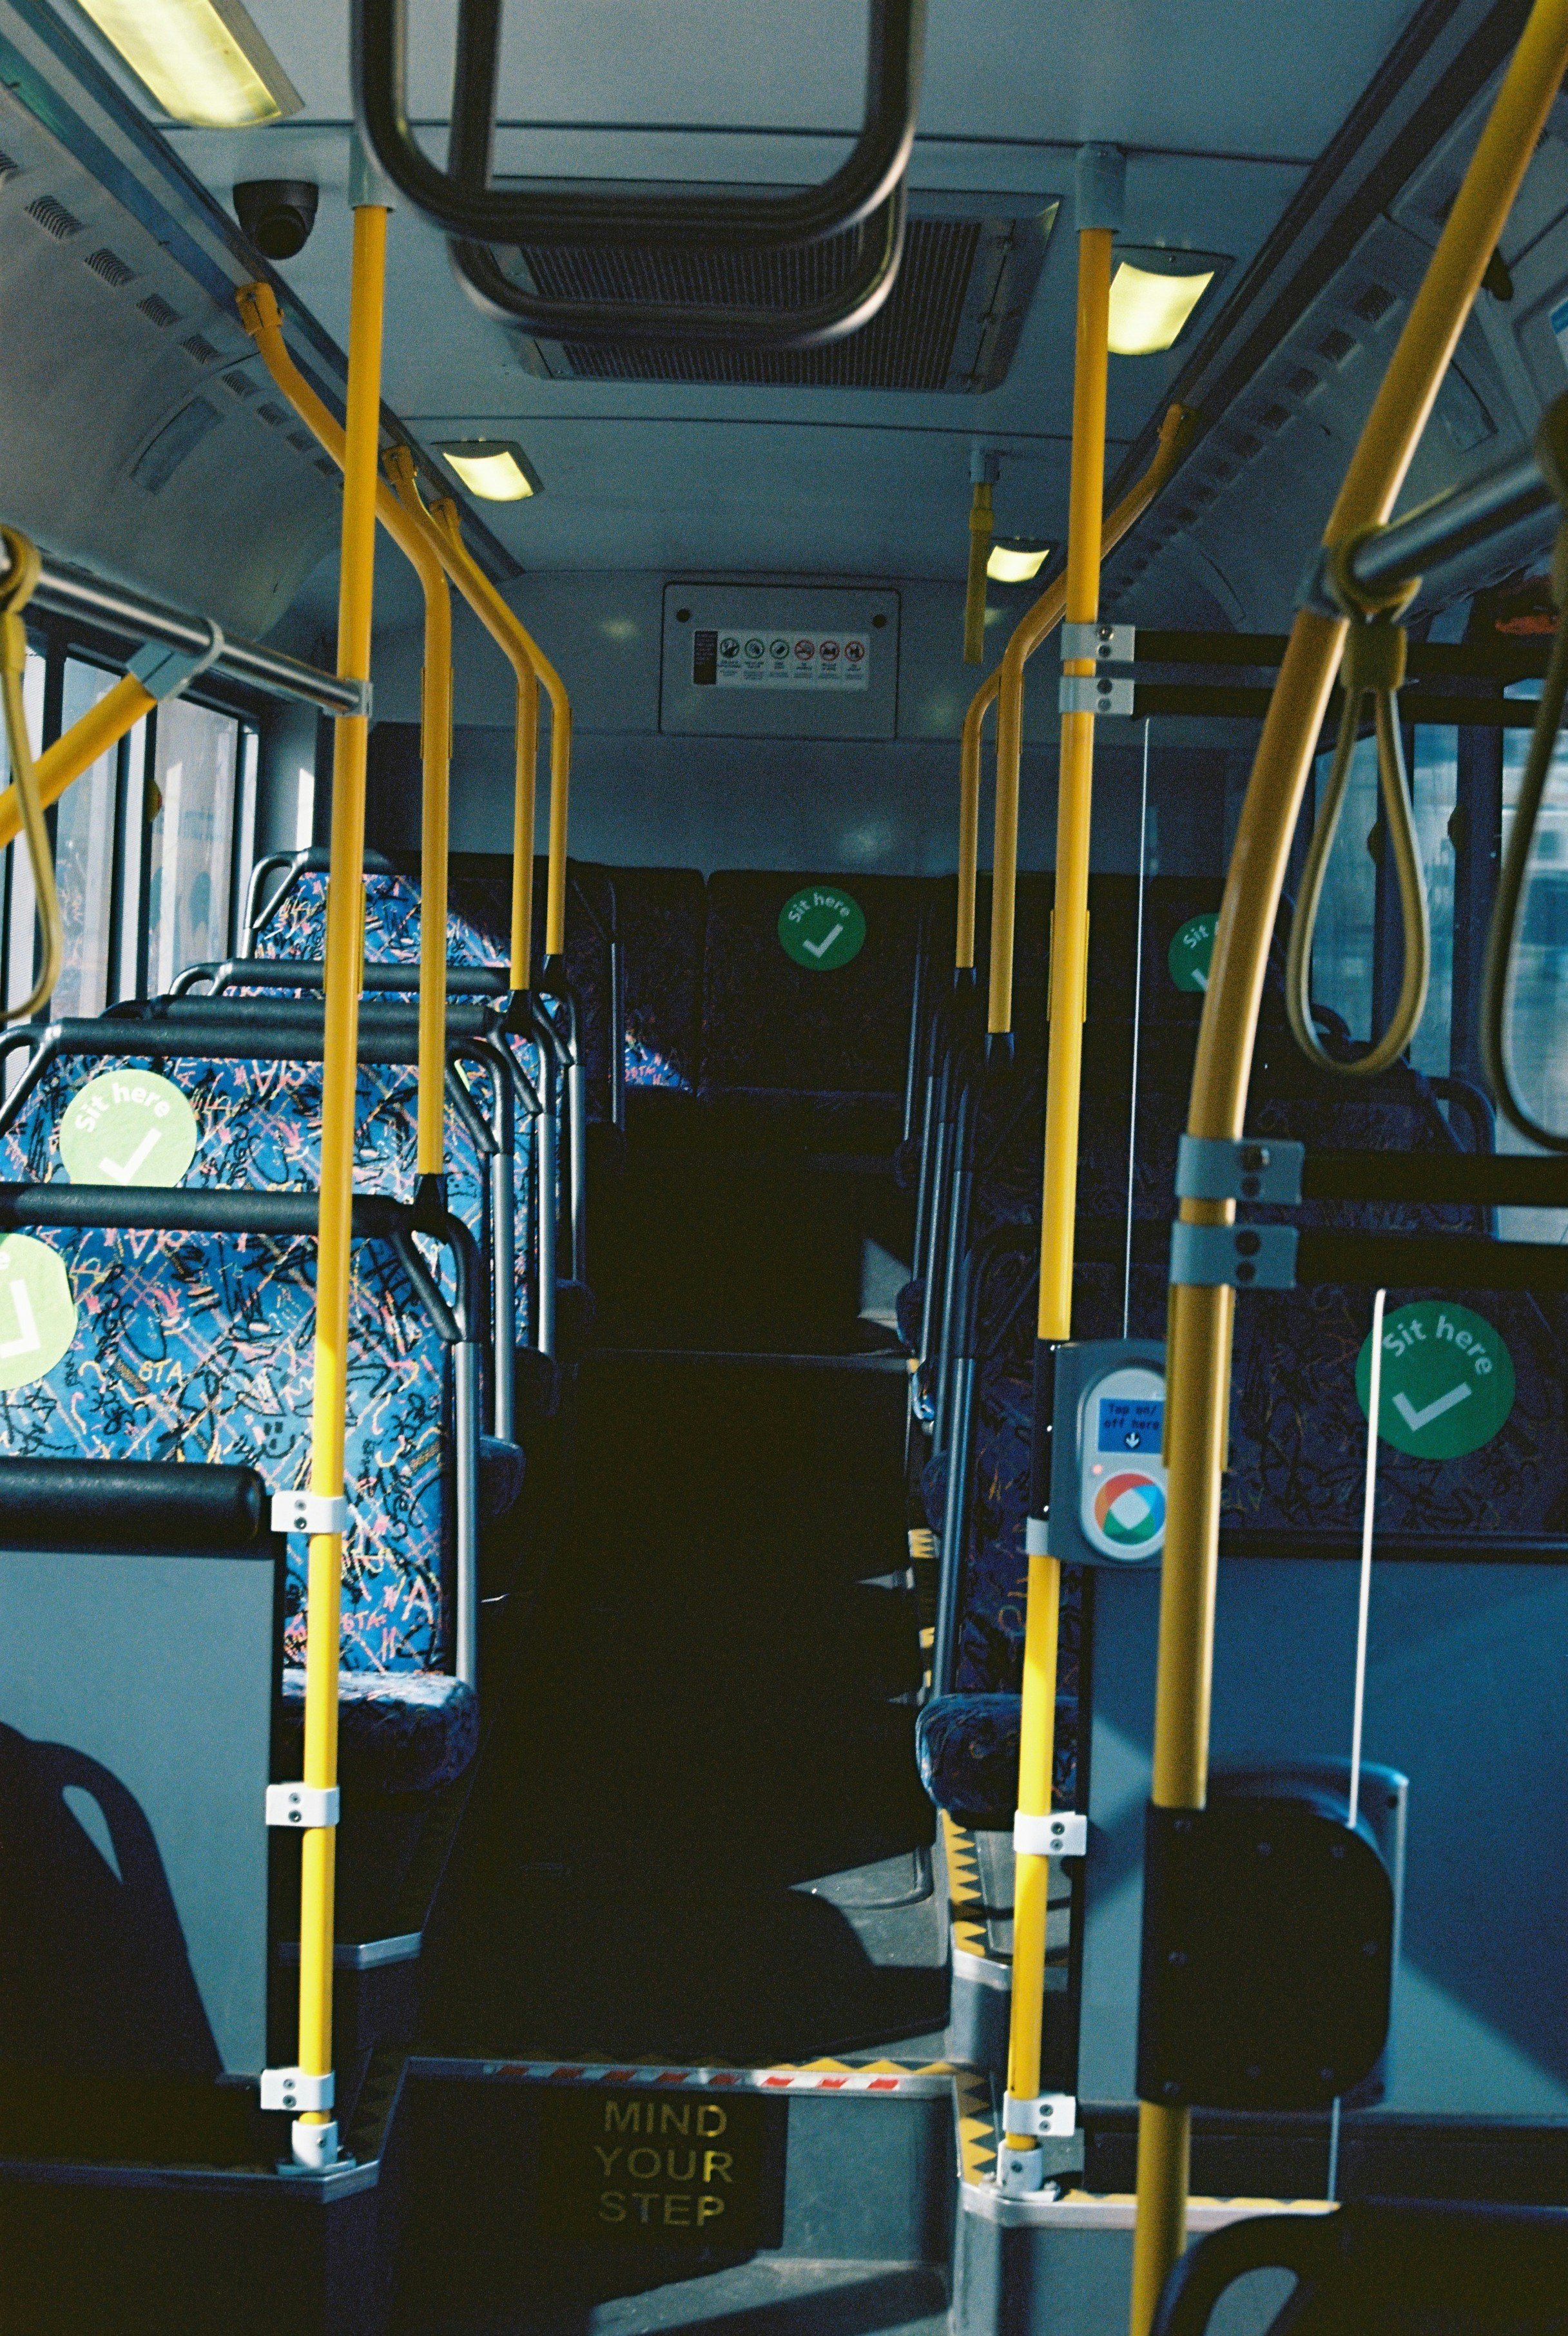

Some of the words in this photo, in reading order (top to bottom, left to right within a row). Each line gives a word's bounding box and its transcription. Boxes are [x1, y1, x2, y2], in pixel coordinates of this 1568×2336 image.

[788, 899, 811, 923] Sit
[813, 891, 851, 917] here
[1183, 925, 1210, 949] Sit
[75, 1094, 110, 1133] Sit
[111, 1082, 171, 1118] here
[1381, 1319, 1426, 1357] Sit
[1435, 1313, 1493, 1375] here
[1103, 1418, 1124, 1429] off
[1132, 1418, 1161, 1429] here
[1108, 1404, 1129, 1416] Tap
[603, 2100, 728, 2138] MIND
[594, 2145, 733, 2183] YOUR
[599, 2190, 725, 2227] STEP
